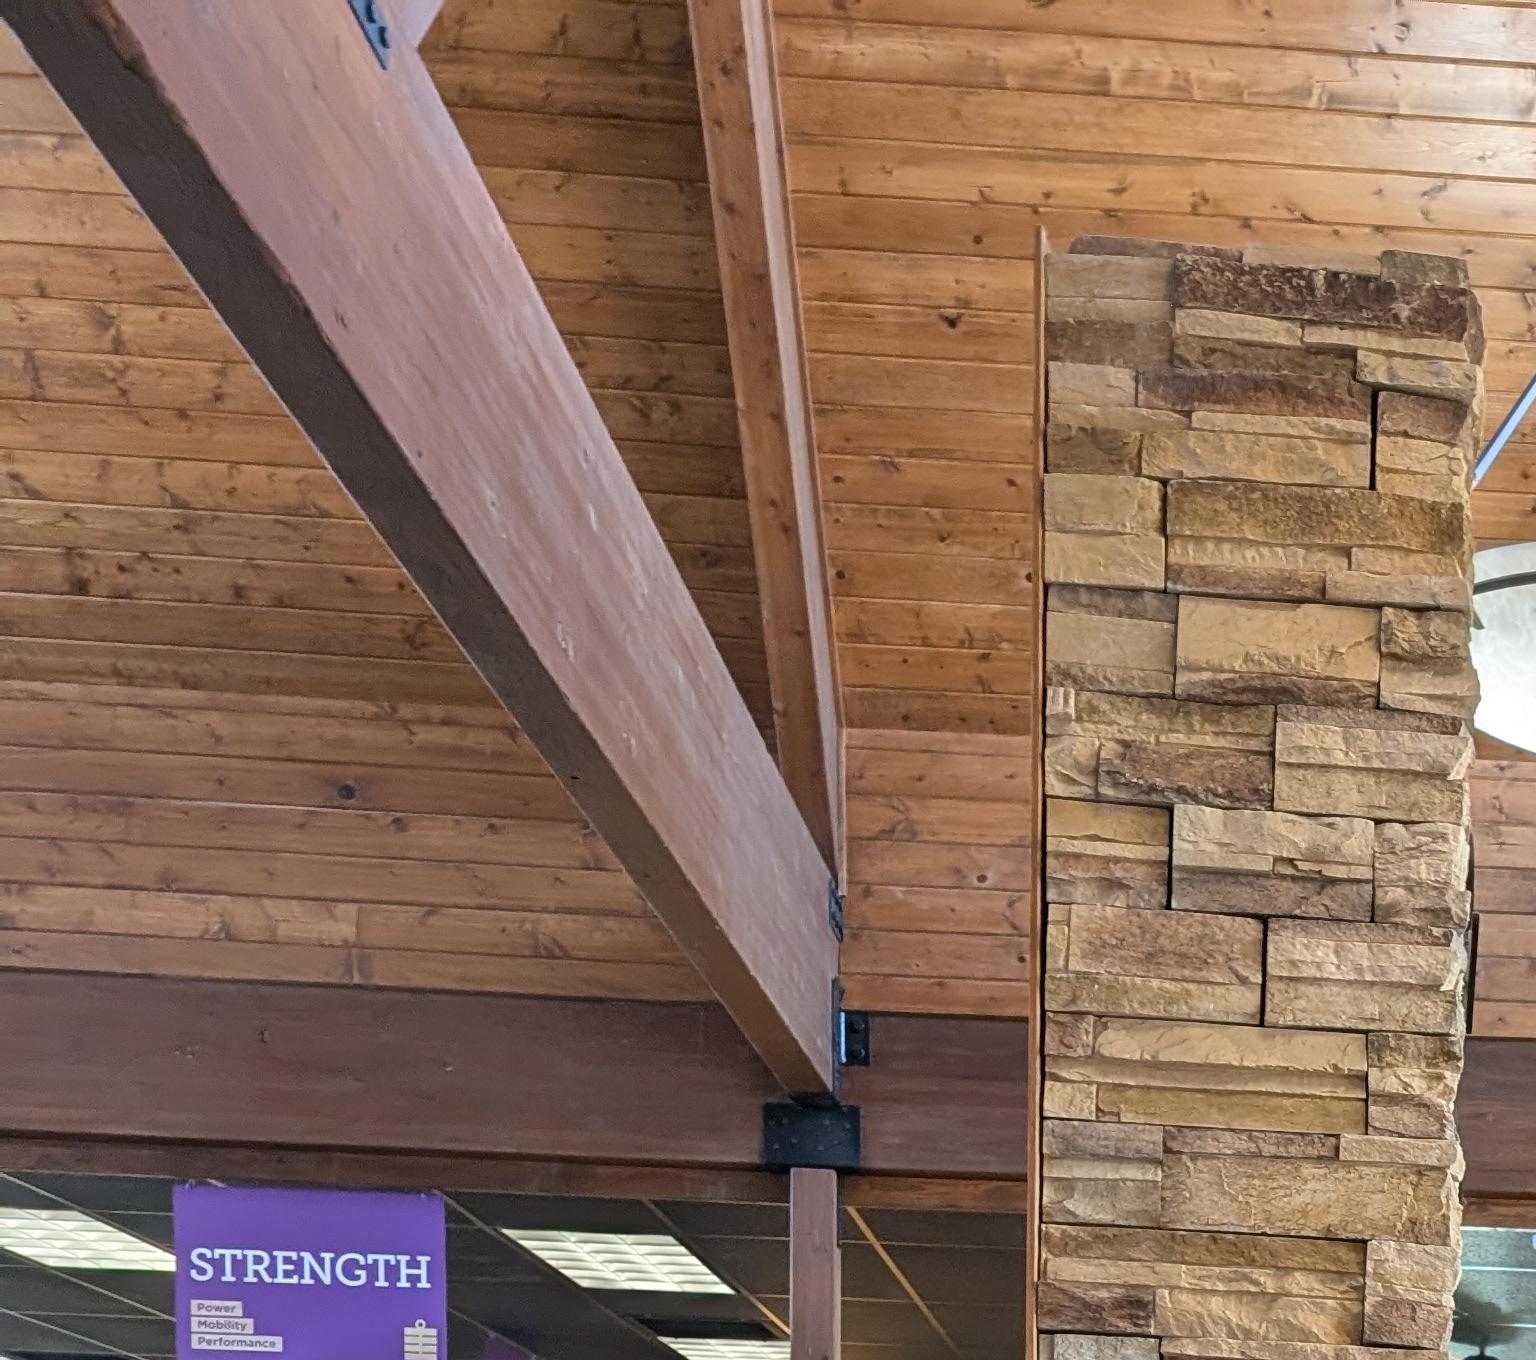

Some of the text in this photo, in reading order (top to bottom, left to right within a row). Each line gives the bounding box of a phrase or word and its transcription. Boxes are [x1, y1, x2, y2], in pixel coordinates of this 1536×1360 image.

[190, 1247, 432, 1289] STRENGTH
[197, 1302, 236, 1314] Power
[197, 1319, 248, 1332] Mobility
[197, 1336, 277, 1349] Performance
